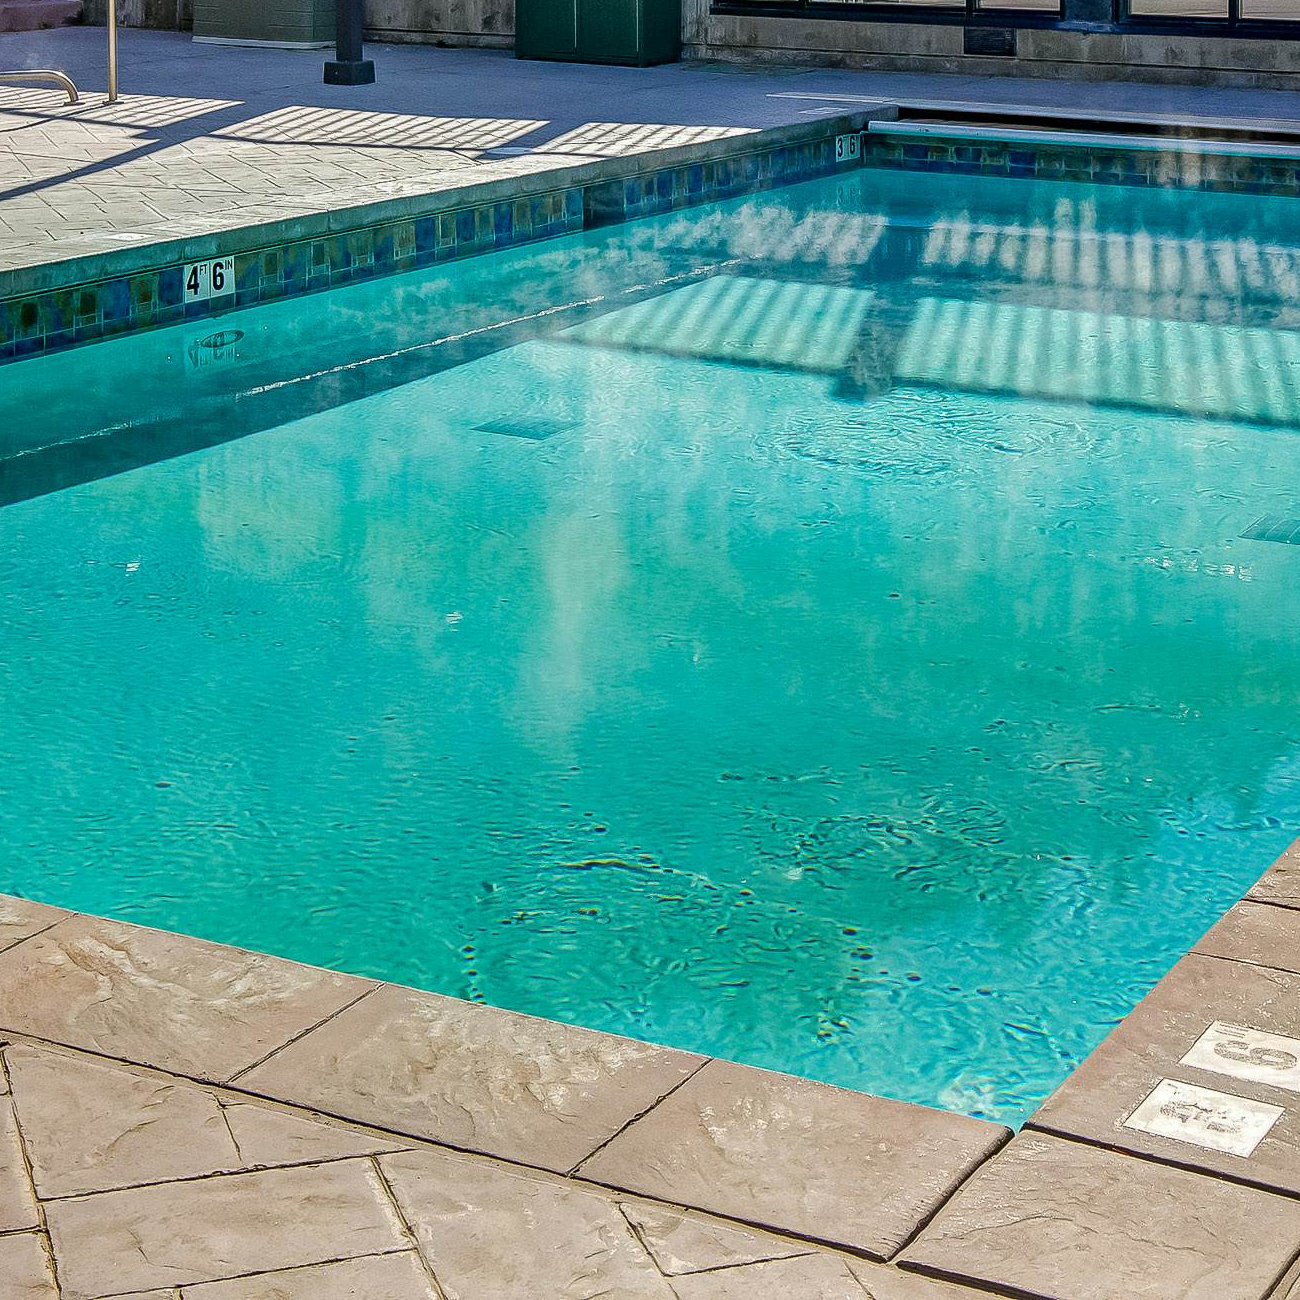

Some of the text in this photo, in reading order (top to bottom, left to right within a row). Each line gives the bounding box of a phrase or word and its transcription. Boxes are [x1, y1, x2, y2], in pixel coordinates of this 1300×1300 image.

[837, 137, 843, 157] 3
[186, 258, 233, 296] 4 FT 6 IN
